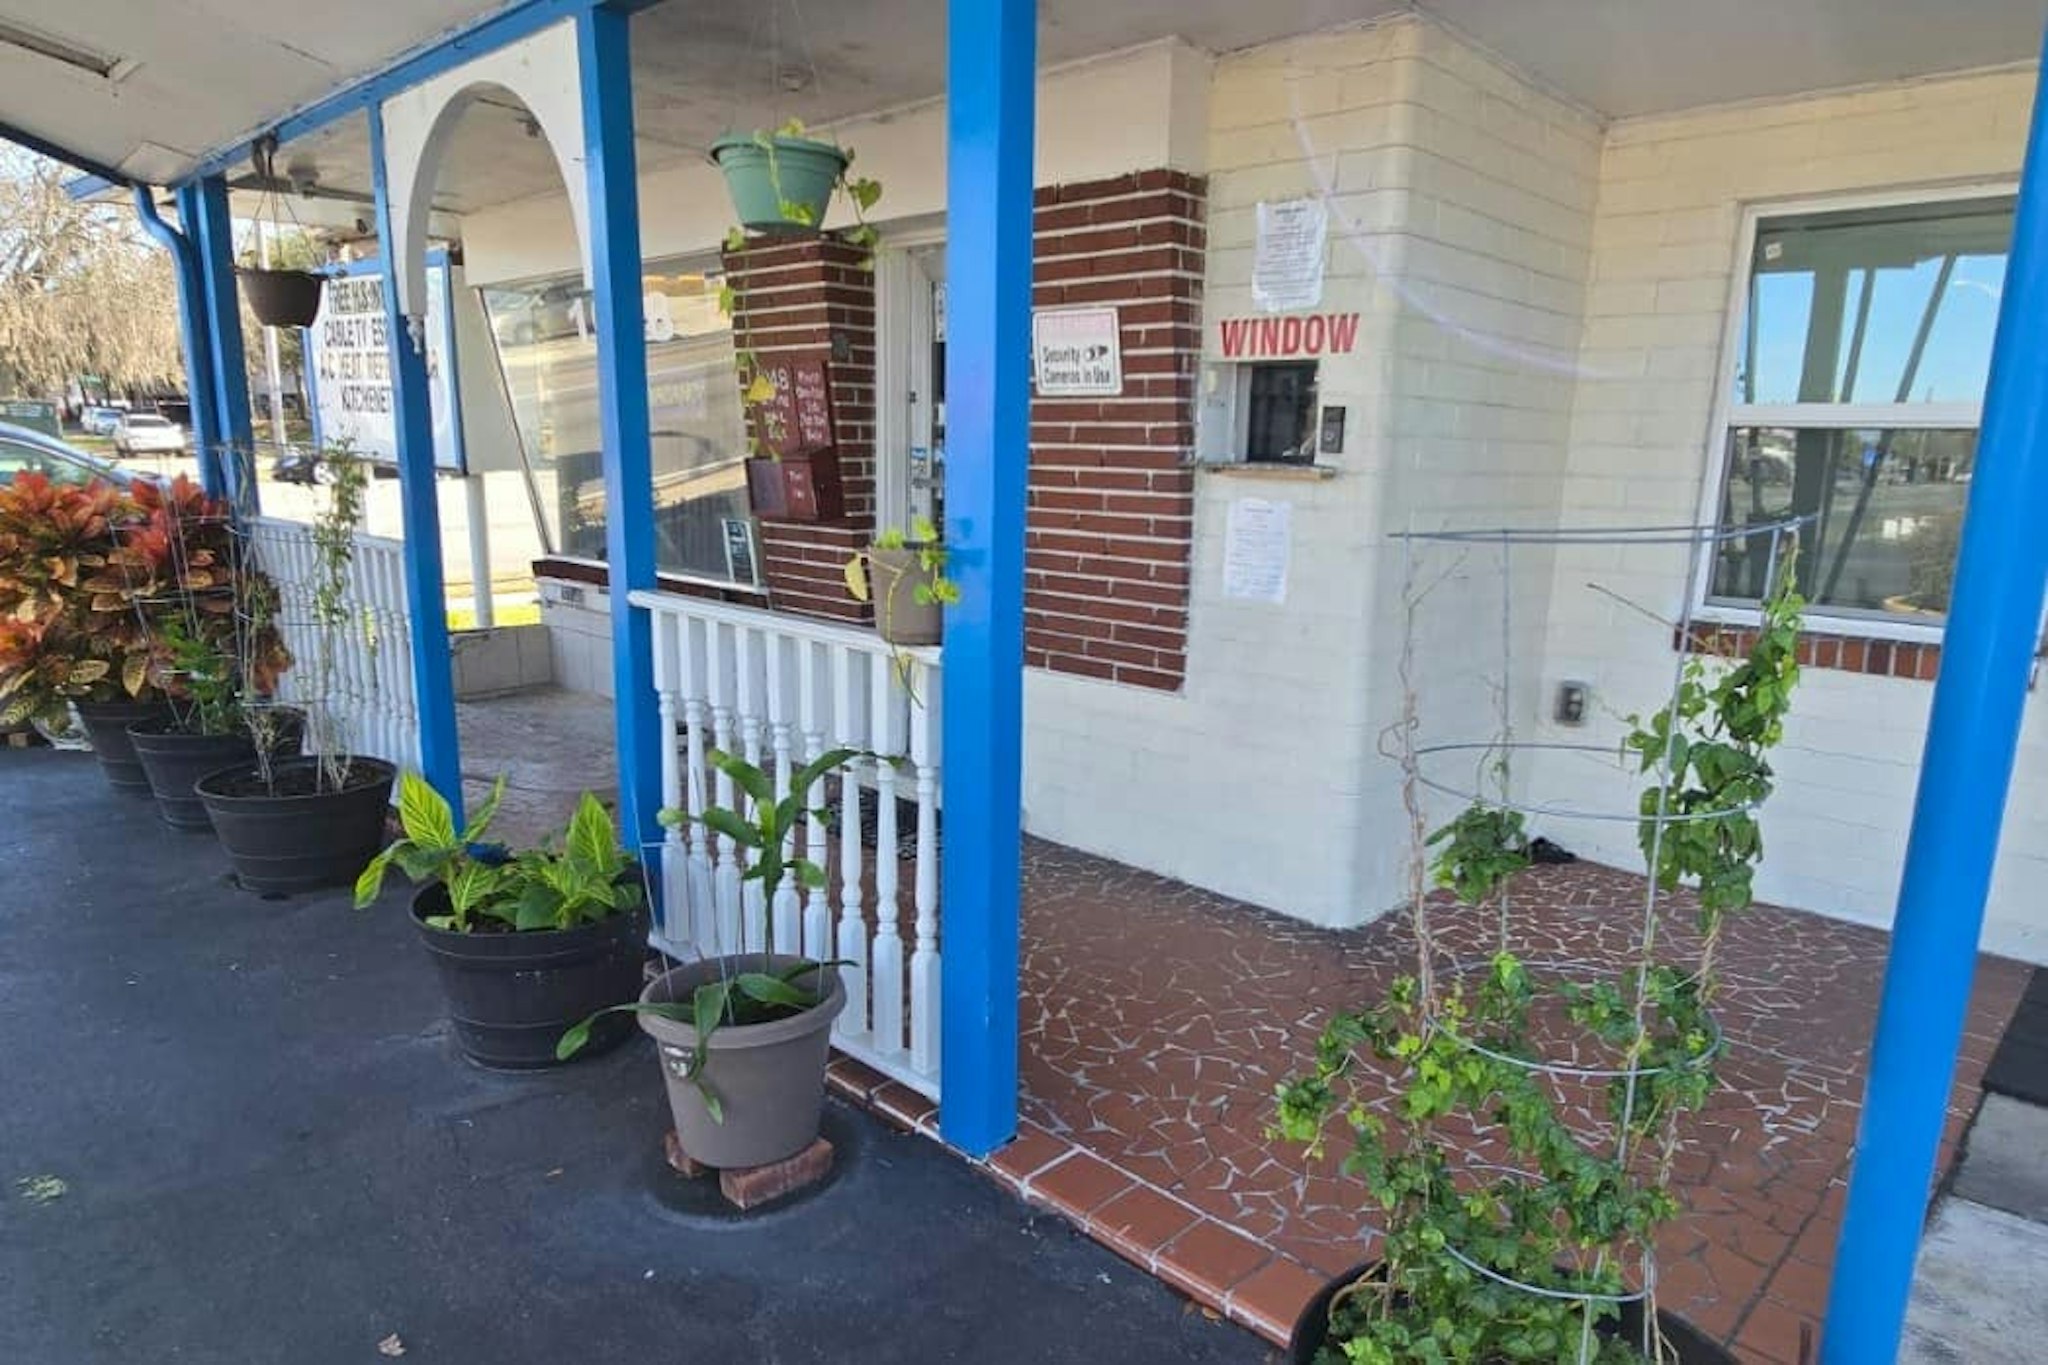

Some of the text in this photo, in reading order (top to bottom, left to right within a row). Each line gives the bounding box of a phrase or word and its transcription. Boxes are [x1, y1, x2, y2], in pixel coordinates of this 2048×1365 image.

[1220, 312, 1360, 357] WINDOW
[1043, 346, 1080, 366] Security
[1045, 366, 1080, 384] Cameras
